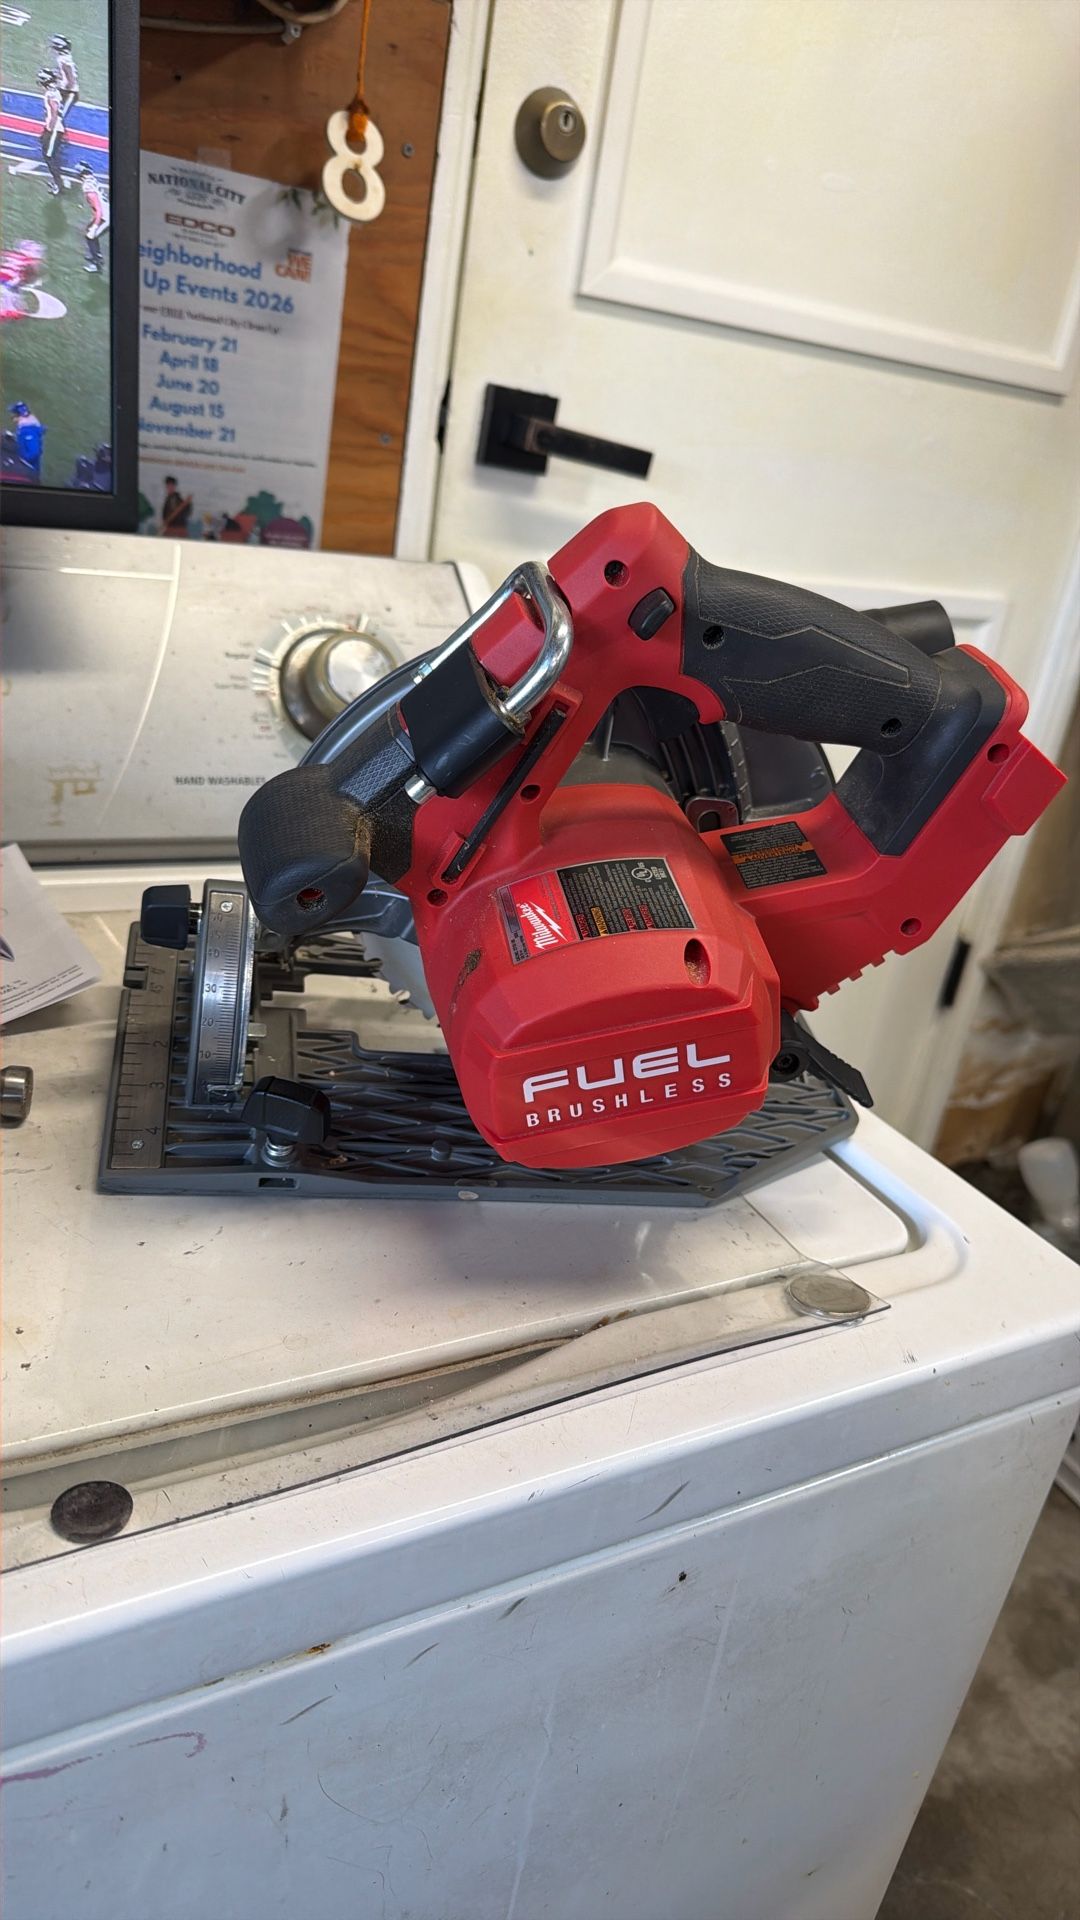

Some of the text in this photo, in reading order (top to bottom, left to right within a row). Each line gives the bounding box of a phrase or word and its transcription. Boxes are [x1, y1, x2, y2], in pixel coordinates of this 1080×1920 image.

[322, 110, 386, 222] 8
[148, 172, 214, 194] NATIONAL
[214, 186, 246, 205] CITY
[164, 212, 236, 237] EDCO
[143, 268, 295, 314] Up Events 2026
[142, 323, 216, 352] February
[220, 336, 238, 353] 21
[159, 350, 219, 373] April 18
[156, 373, 220, 396] June 20
[150, 396, 225, 419] August 15
[219, 426, 236, 443] 21
[174, 775, 205, 786] HAND
[204, 983, 218, 994] 30
[201, 1018, 215, 1028] 20
[152, 1039, 168, 1049] 2
[150, 1080, 166, 1090] 3
[522, 1043, 731, 1104] FUEL
[526, 1073, 732, 1128] BRUSHLESS
[145, 1125, 162, 1136] 4
